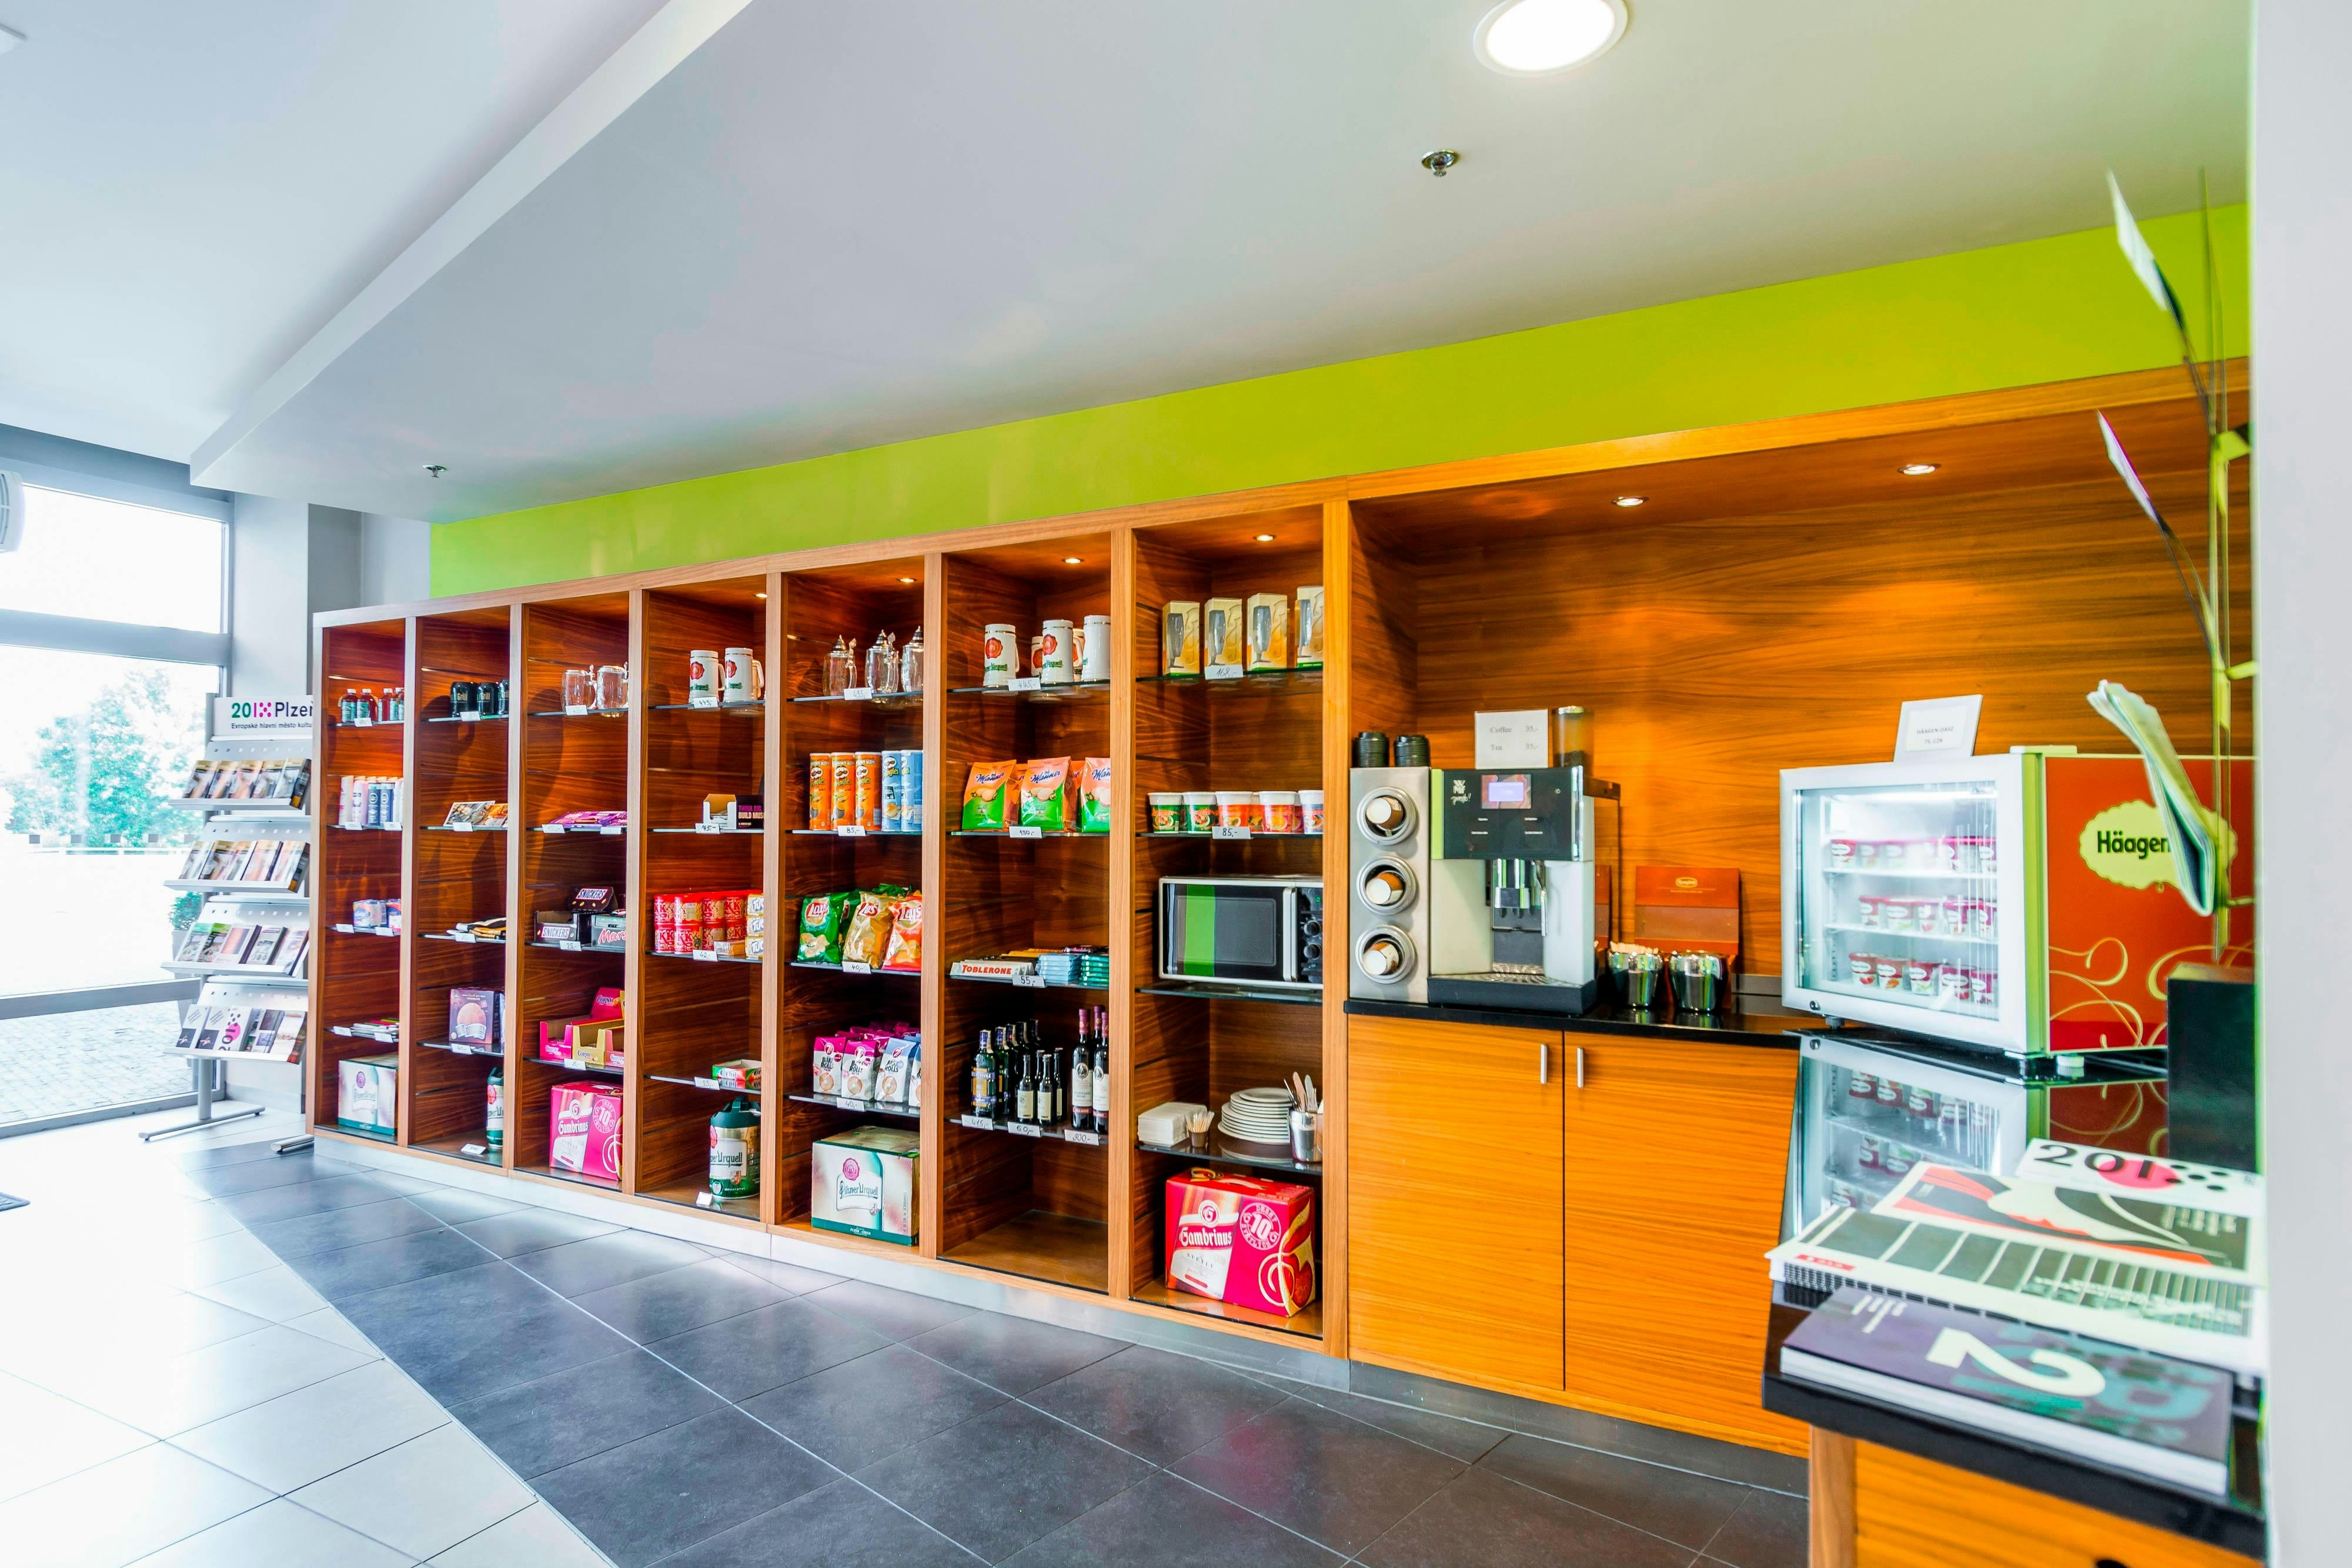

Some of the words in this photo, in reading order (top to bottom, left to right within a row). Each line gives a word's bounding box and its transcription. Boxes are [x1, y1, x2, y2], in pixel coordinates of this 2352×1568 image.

[1031, 770, 1061, 784] Manner
[1222, 828, 1238, 837] 85,-
[2097, 831, 2171, 860] Häagen
[577, 890, 606, 898] SNICKERS
[543, 928, 569, 938] SNICKERS
[961, 964, 1012, 975] TOBLERONE
[1021, 975, 1035, 987] 55,-
[558, 1120, 588, 1135] Gambrinus
[717, 1150, 743, 1168] Urquell
[1251, 1212, 1272, 1240] 10
[1180, 1227, 1232, 1246] Gambrinus
